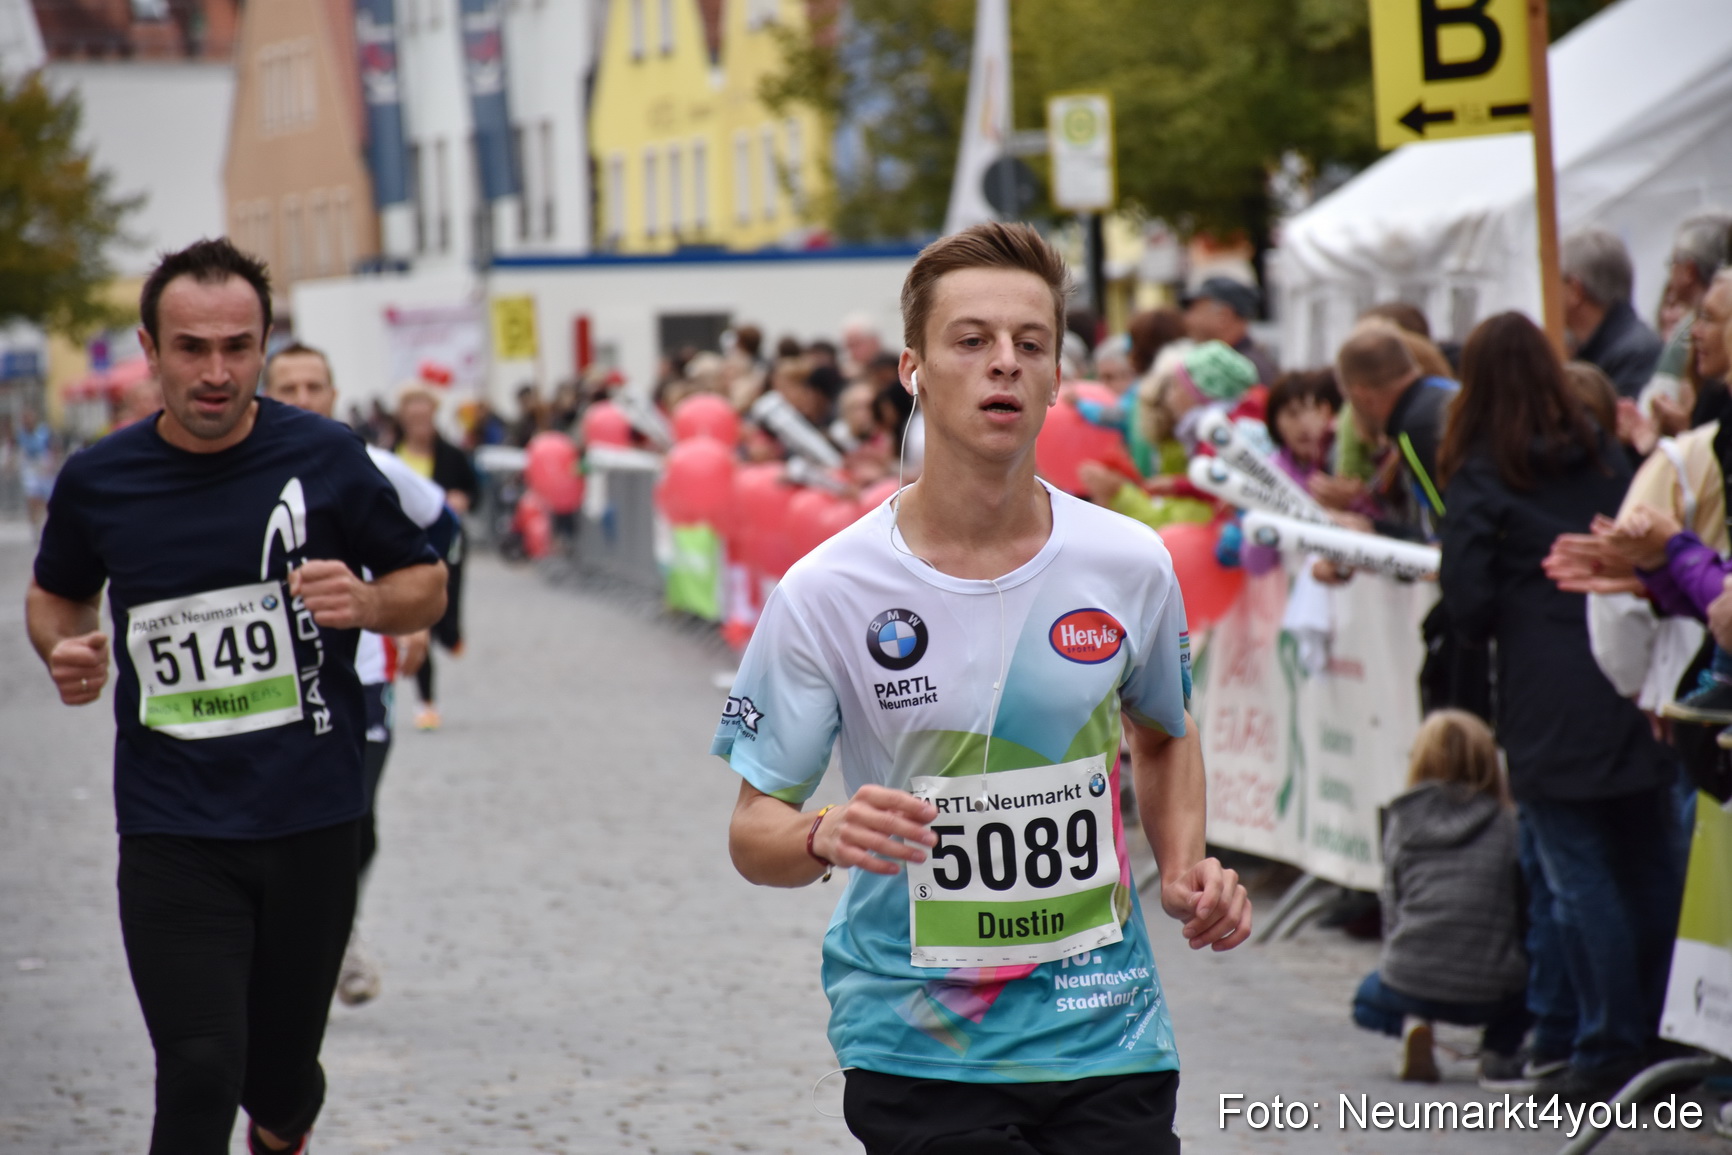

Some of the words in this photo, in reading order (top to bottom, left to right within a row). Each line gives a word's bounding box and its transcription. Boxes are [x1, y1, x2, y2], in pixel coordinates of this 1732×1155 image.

[1420, 0, 1502, 82] B
[133, 615, 179, 635] PARTL
[181, 601, 255, 625] Neumarkt
[1060, 624, 1118, 649] Hervis
[1066, 645, 1096, 654] SPORTS
[148, 620, 279, 687] 5149
[874, 676, 937, 699] PARTL
[878, 692, 938, 710] Neumarkt
[985, 784, 1082, 812] Neumarkt
[931, 809, 1099, 891] 5089
[919, 885, 928, 898] S
[978, 909, 1065, 939] Dustin
[1054, 967, 1150, 990] Neumarkter
[1056, 986, 1140, 1012] Stadtlauf
[1131, 1003, 1158, 1041] September
[1125, 1040, 1138, 1051] 20.
